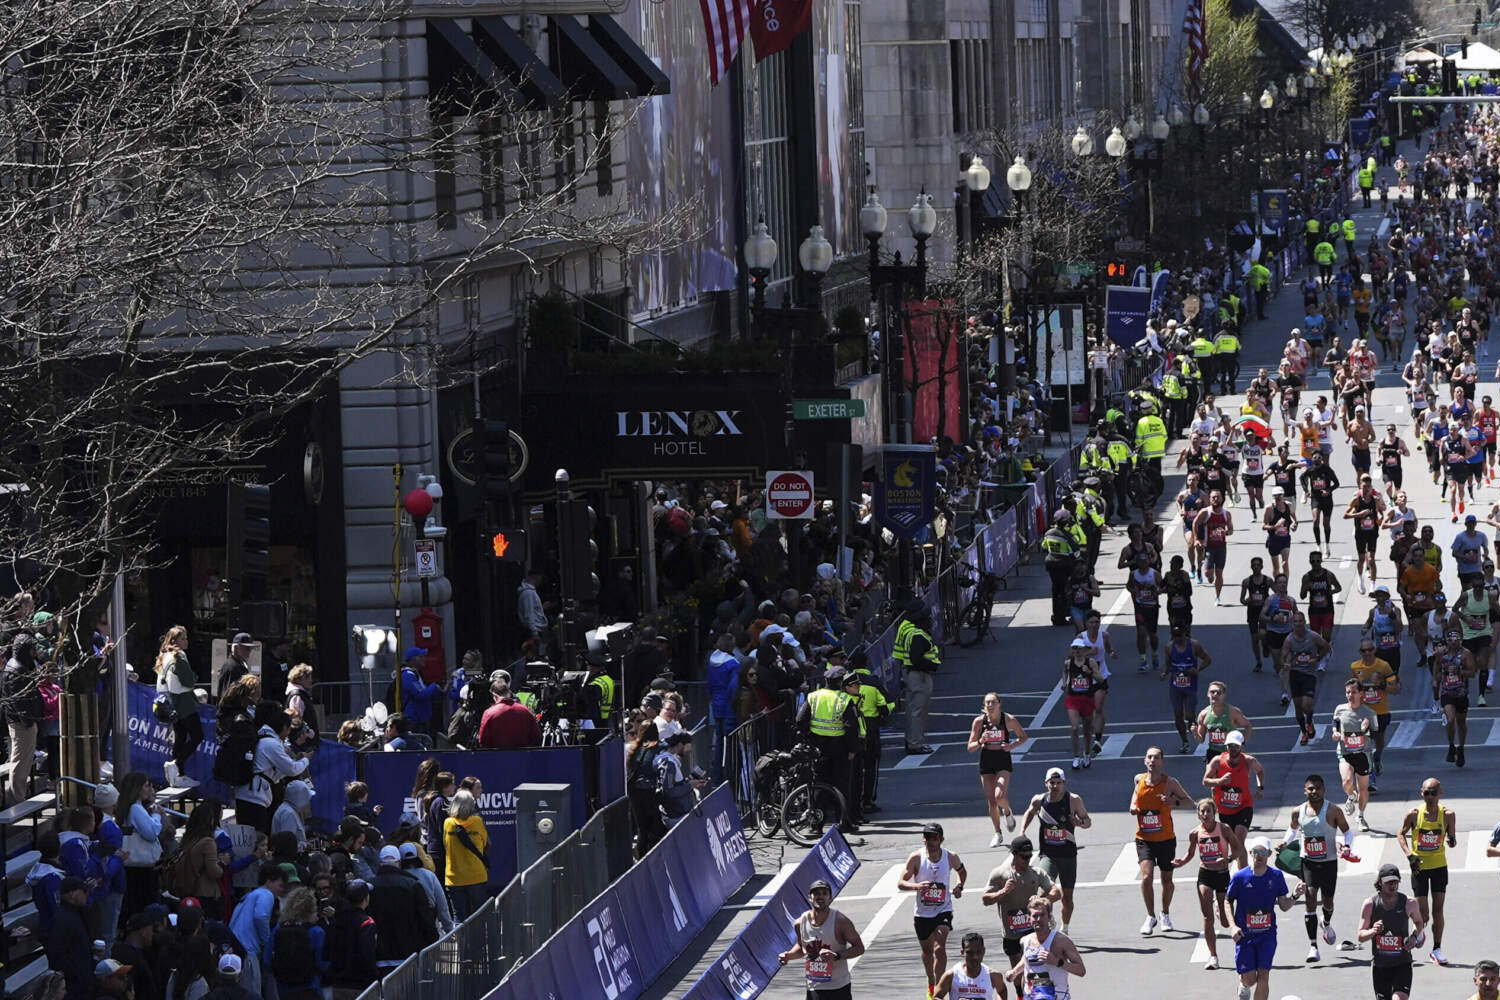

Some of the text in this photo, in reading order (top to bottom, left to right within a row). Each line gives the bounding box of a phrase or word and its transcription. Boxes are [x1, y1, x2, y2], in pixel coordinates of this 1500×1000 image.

[808, 403, 847, 417] EXETER
[654, 441, 707, 455] HOTEL
[774, 482, 806, 490] DO NOT
[778, 500, 803, 508] ENTER
[1380, 937, 1398, 946] 4552
